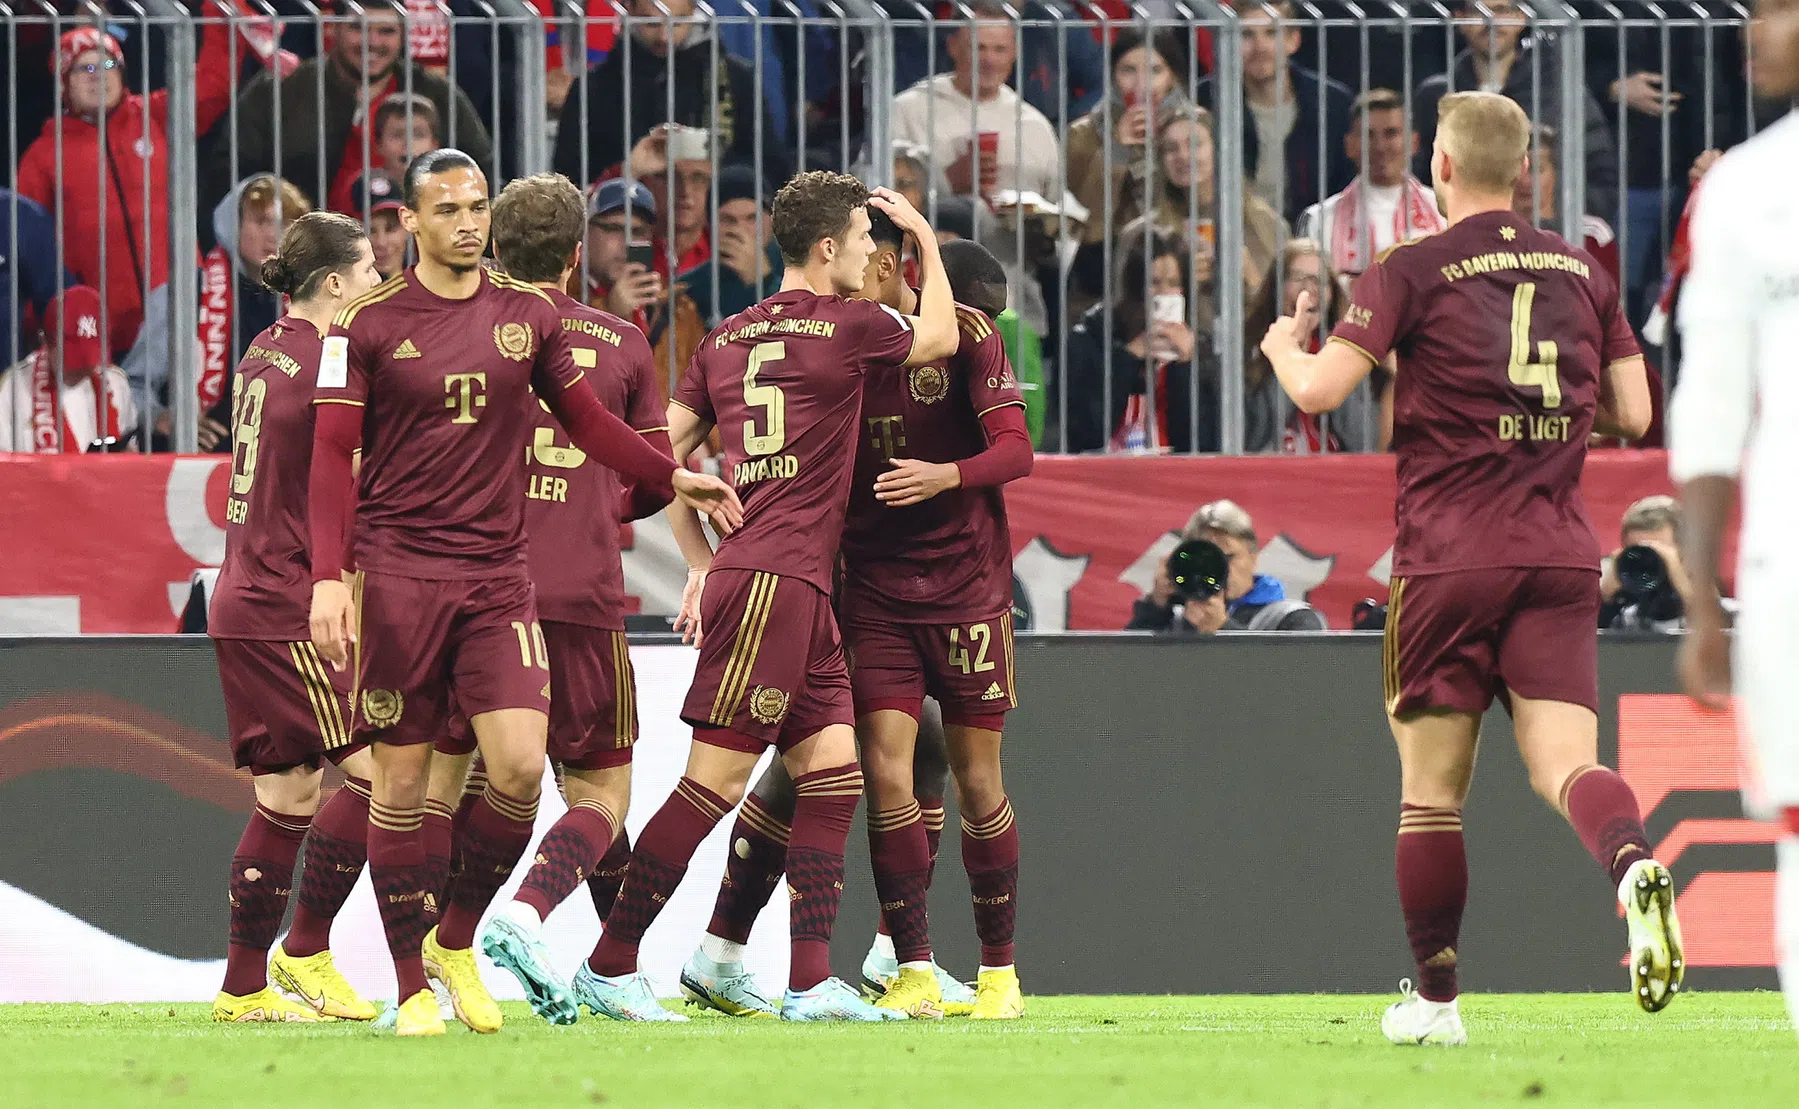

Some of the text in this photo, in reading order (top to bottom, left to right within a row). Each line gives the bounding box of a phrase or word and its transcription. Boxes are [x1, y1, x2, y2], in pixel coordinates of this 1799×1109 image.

[1441, 263, 1463, 283] FC
[1461, 252, 1519, 277] BAYERN
[715, 331, 728, 350] FC
[1508, 282, 1562, 409] 4
[742, 341, 786, 456] 5
[1499, 414, 1572, 443] DE LIGT
[734, 455, 799, 487] PAVARD
[525, 474, 568, 503] LER
[511, 621, 550, 671] 10
[948, 623, 995, 674] 42
